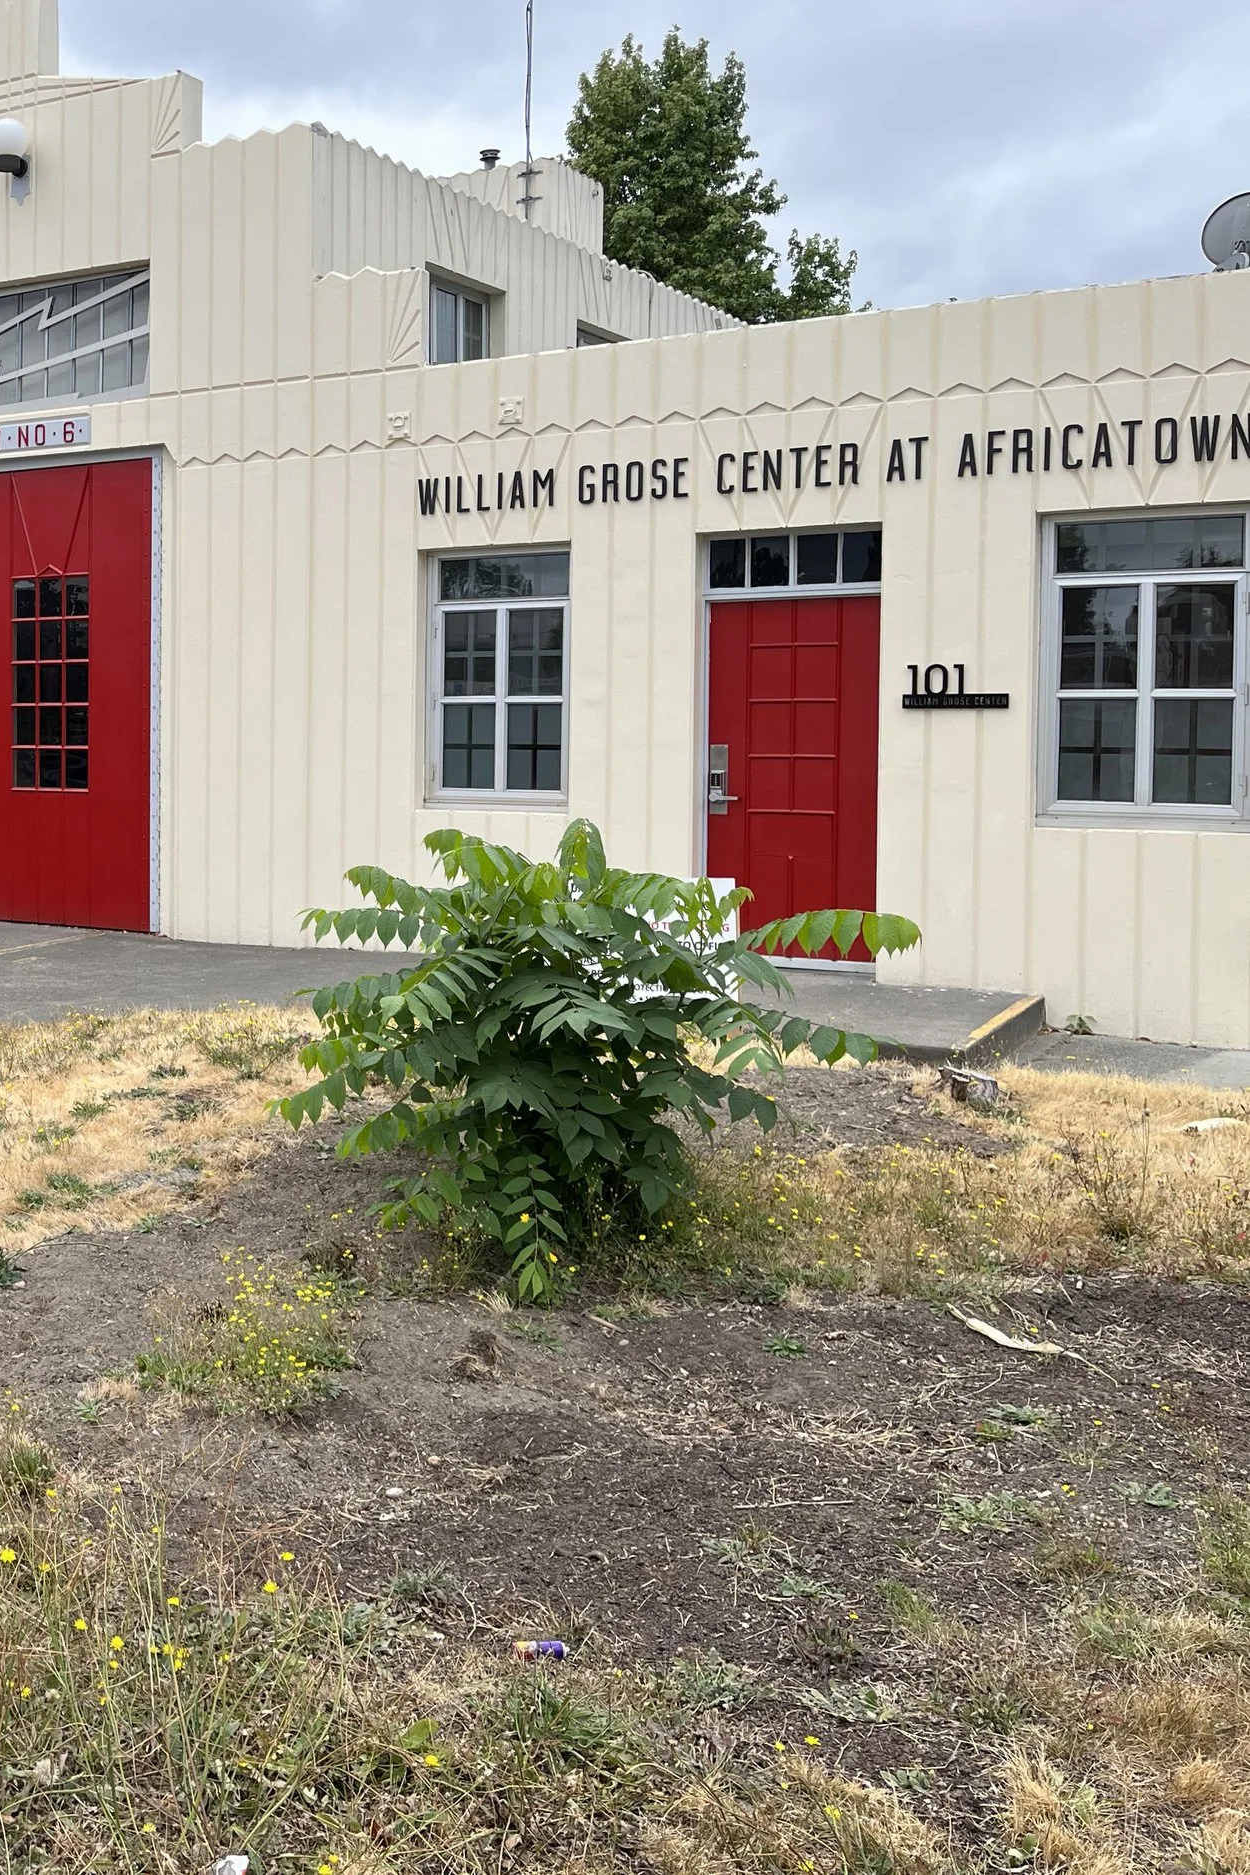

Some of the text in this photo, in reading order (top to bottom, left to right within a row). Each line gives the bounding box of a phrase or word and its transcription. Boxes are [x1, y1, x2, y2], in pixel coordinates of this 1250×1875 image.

[18, 424, 46, 448] NO
[418, 413, 1250, 516] WILLIAM GROSE CENTER AT AFRICATOWN
[907, 664, 965, 695] 101
[904, 697, 939, 706] WILLIAM
[975, 696, 1007, 706] CENTER
